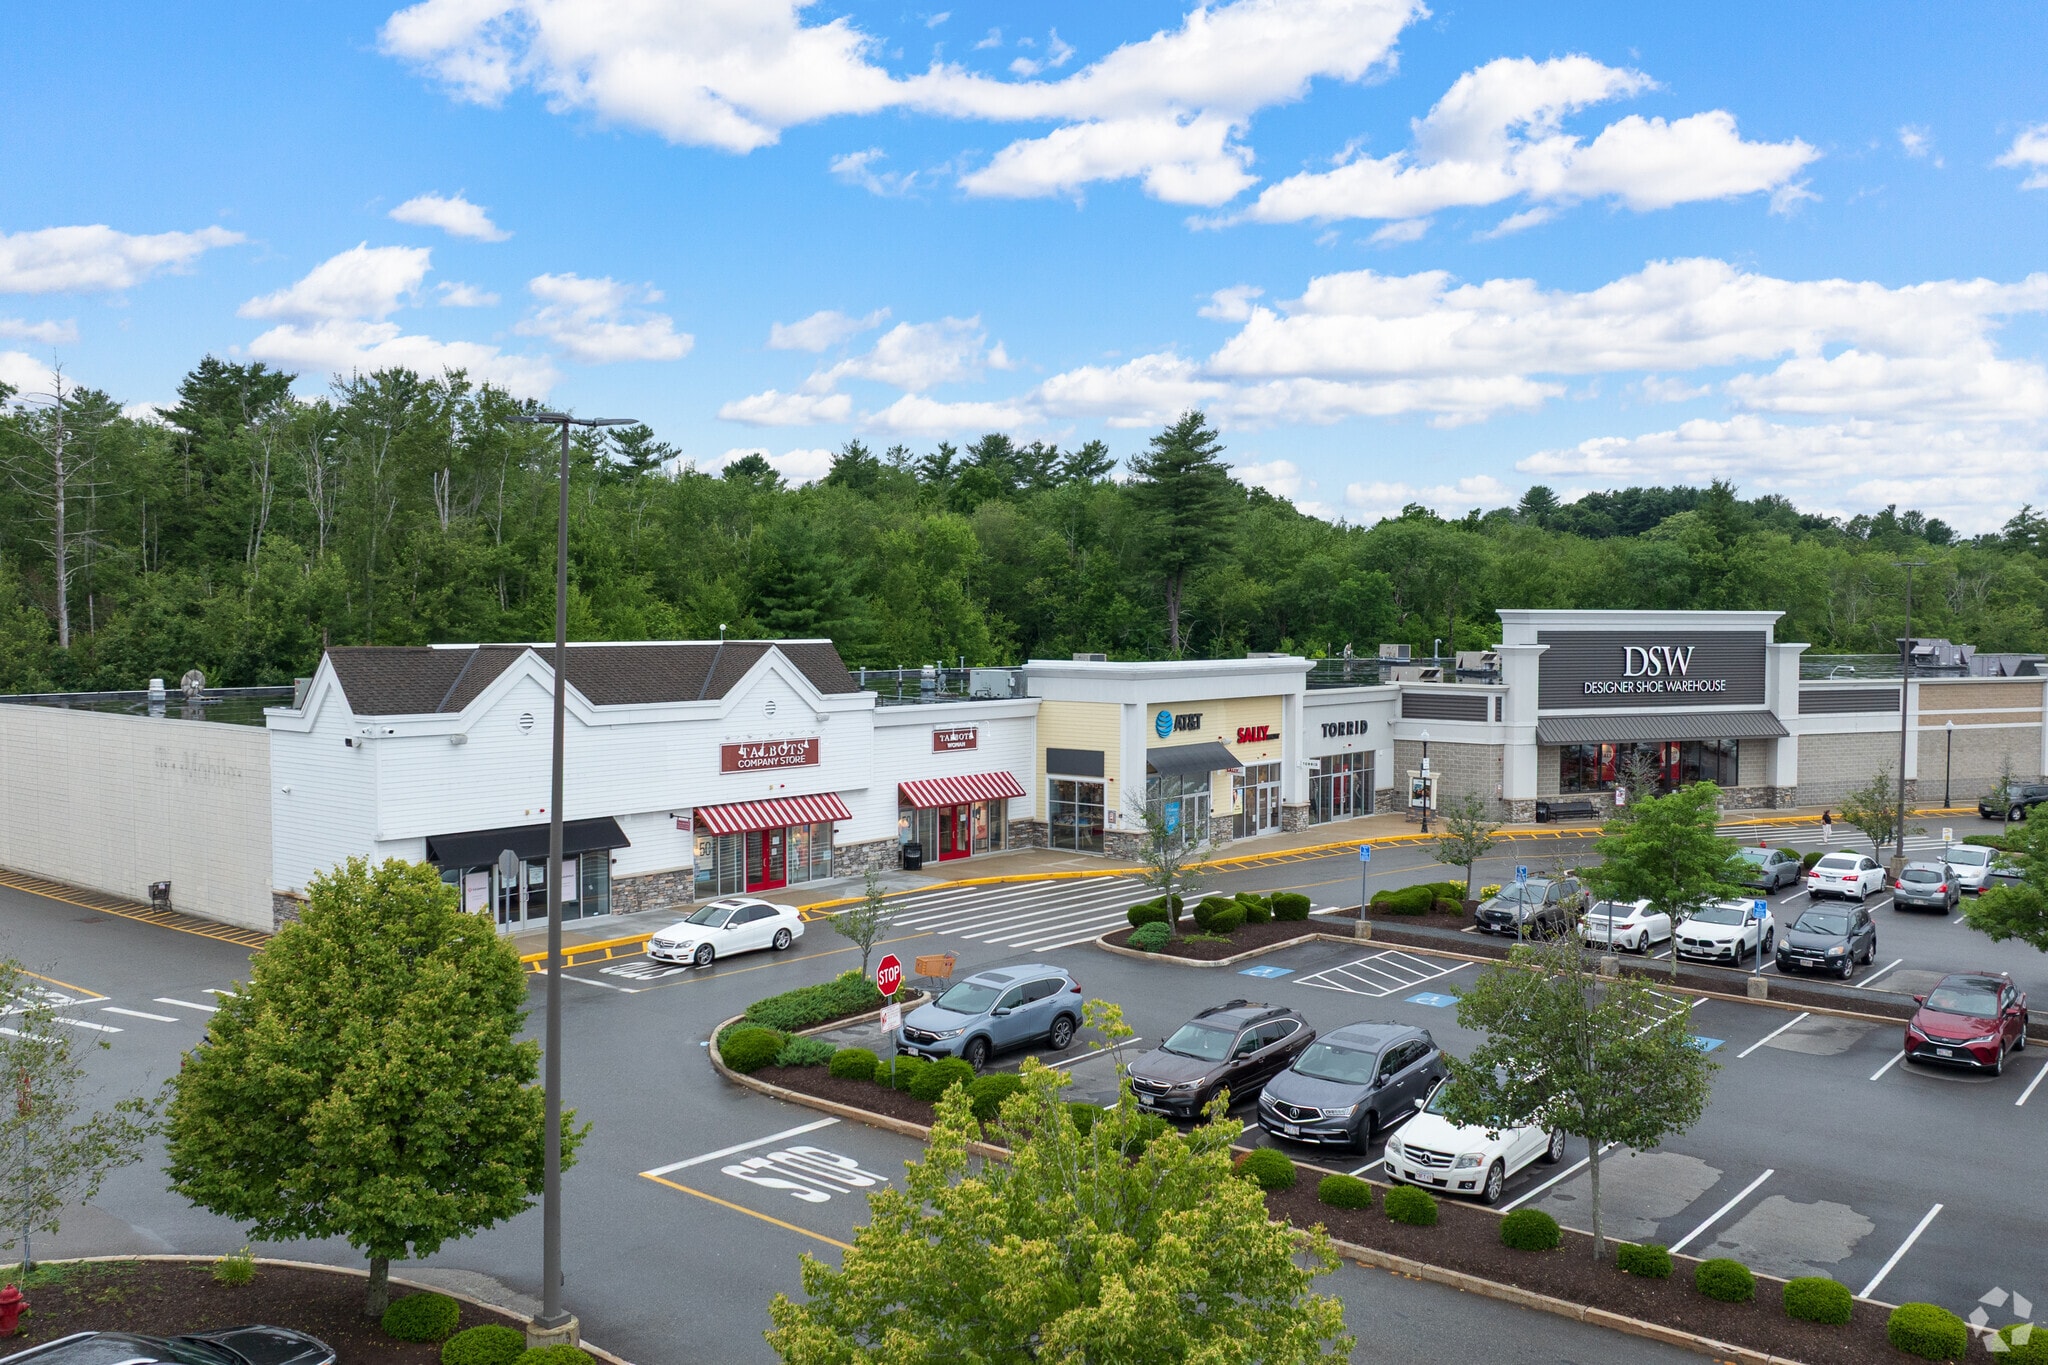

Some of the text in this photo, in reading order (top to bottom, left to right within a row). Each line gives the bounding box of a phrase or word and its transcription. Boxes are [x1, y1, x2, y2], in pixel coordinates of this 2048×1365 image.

[1622, 646, 1695, 677] DSW
[1583, 679, 1727, 694] DESIGNER SHOE WAREHOUSE
[1173, 713, 1203, 732] AT&T
[1321, 719, 1368, 738] TORRID
[1237, 725, 1270, 744] SALLY
[740, 743, 804, 759] TALBOTS
[738, 755, 806, 768] COMPANY STORE
[878, 965, 900, 986] STOP
[720, 1145, 889, 1203] STOP
